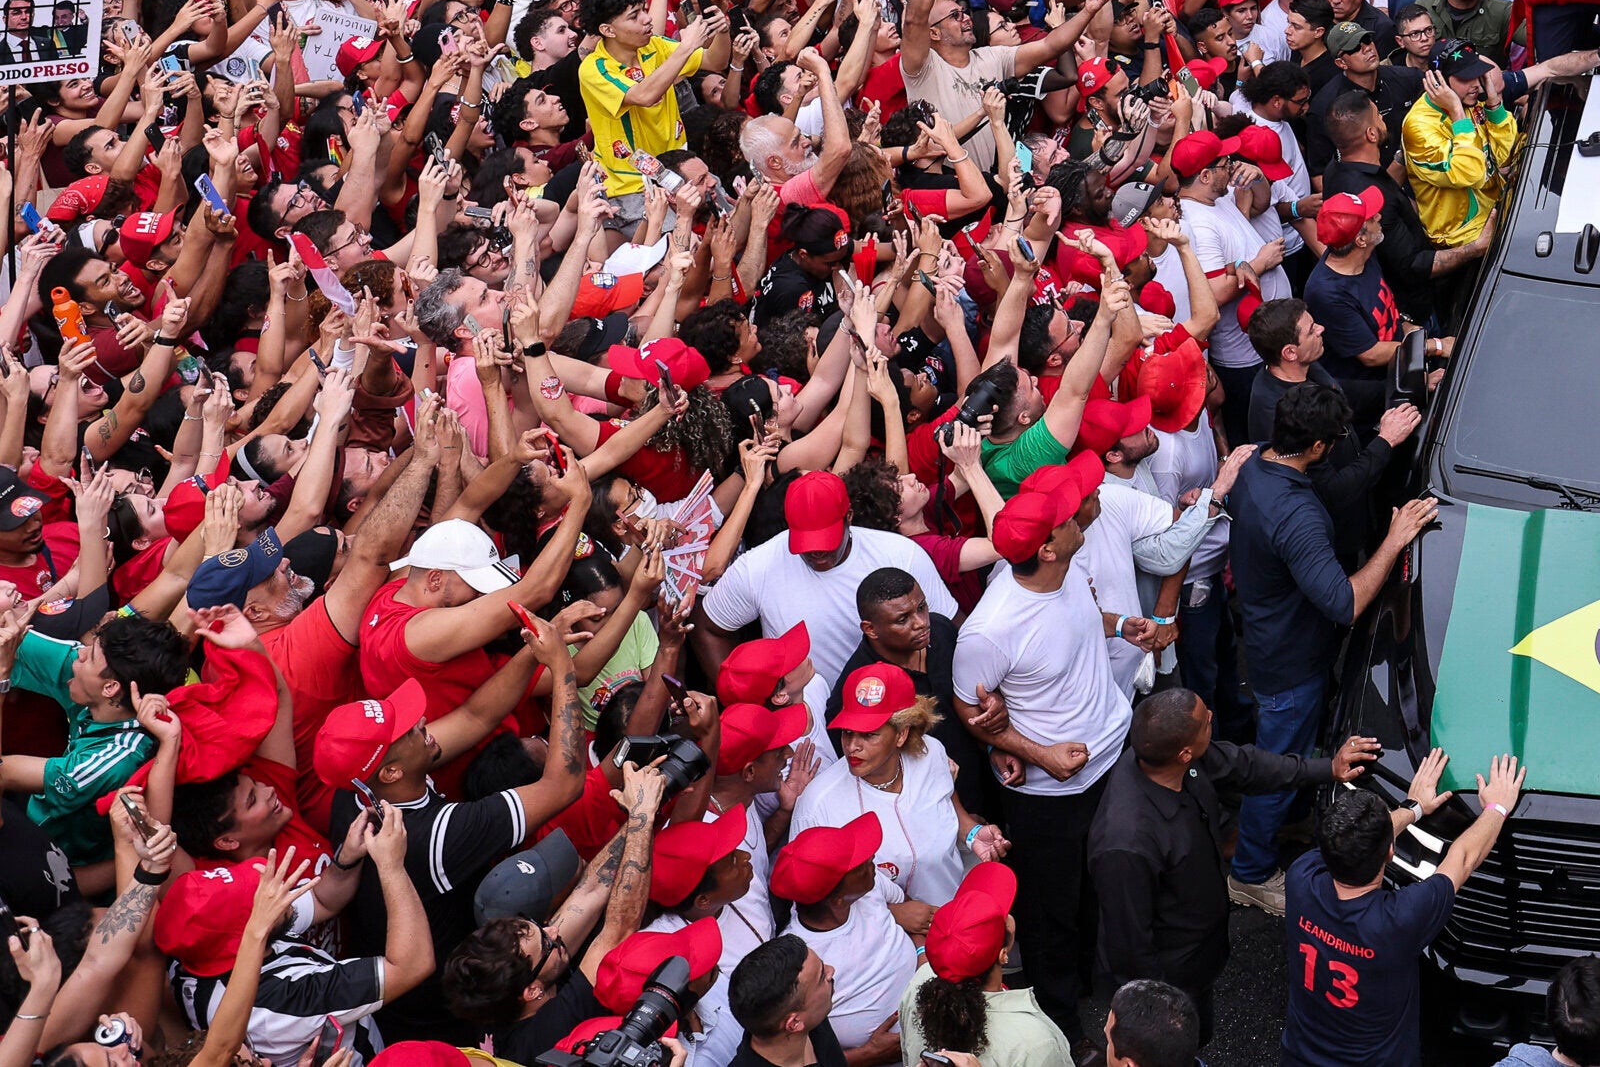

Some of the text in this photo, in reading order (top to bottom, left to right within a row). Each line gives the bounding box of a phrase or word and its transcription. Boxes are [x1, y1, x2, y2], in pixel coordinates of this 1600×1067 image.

[319, 13, 373, 33] MILICIANO
[33, 61, 90, 79] PRESO
[1298, 915, 1375, 960] LEANDRINHO
[1299, 942, 1359, 1008] 13
